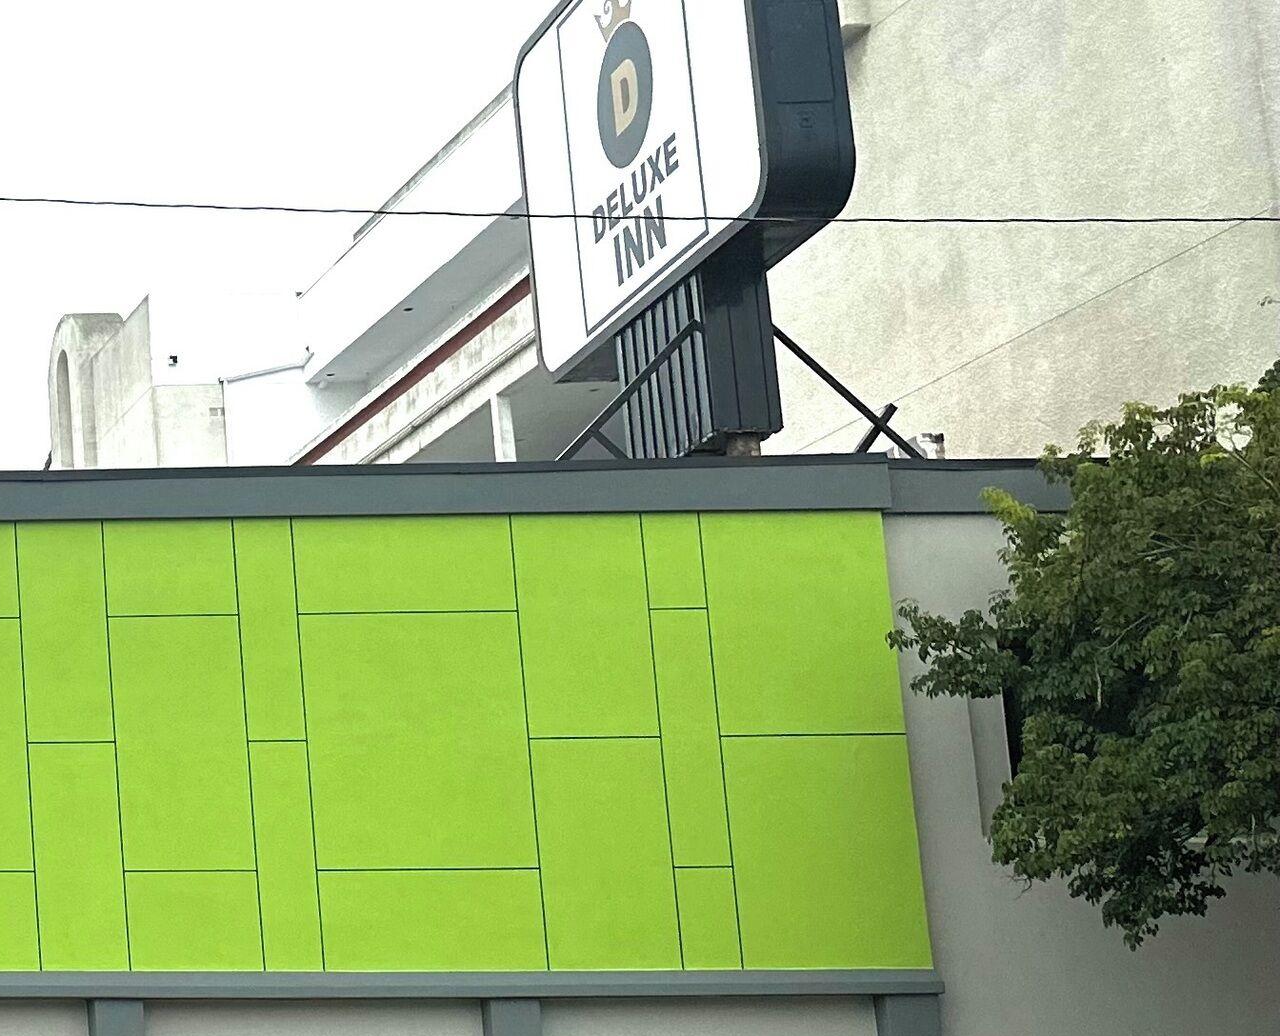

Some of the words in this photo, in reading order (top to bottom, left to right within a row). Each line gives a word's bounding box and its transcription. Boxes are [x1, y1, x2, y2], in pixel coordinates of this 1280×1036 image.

[610, 58, 639, 137] D
[592, 132, 679, 244] DELUXE
[613, 195, 668, 287] INN
